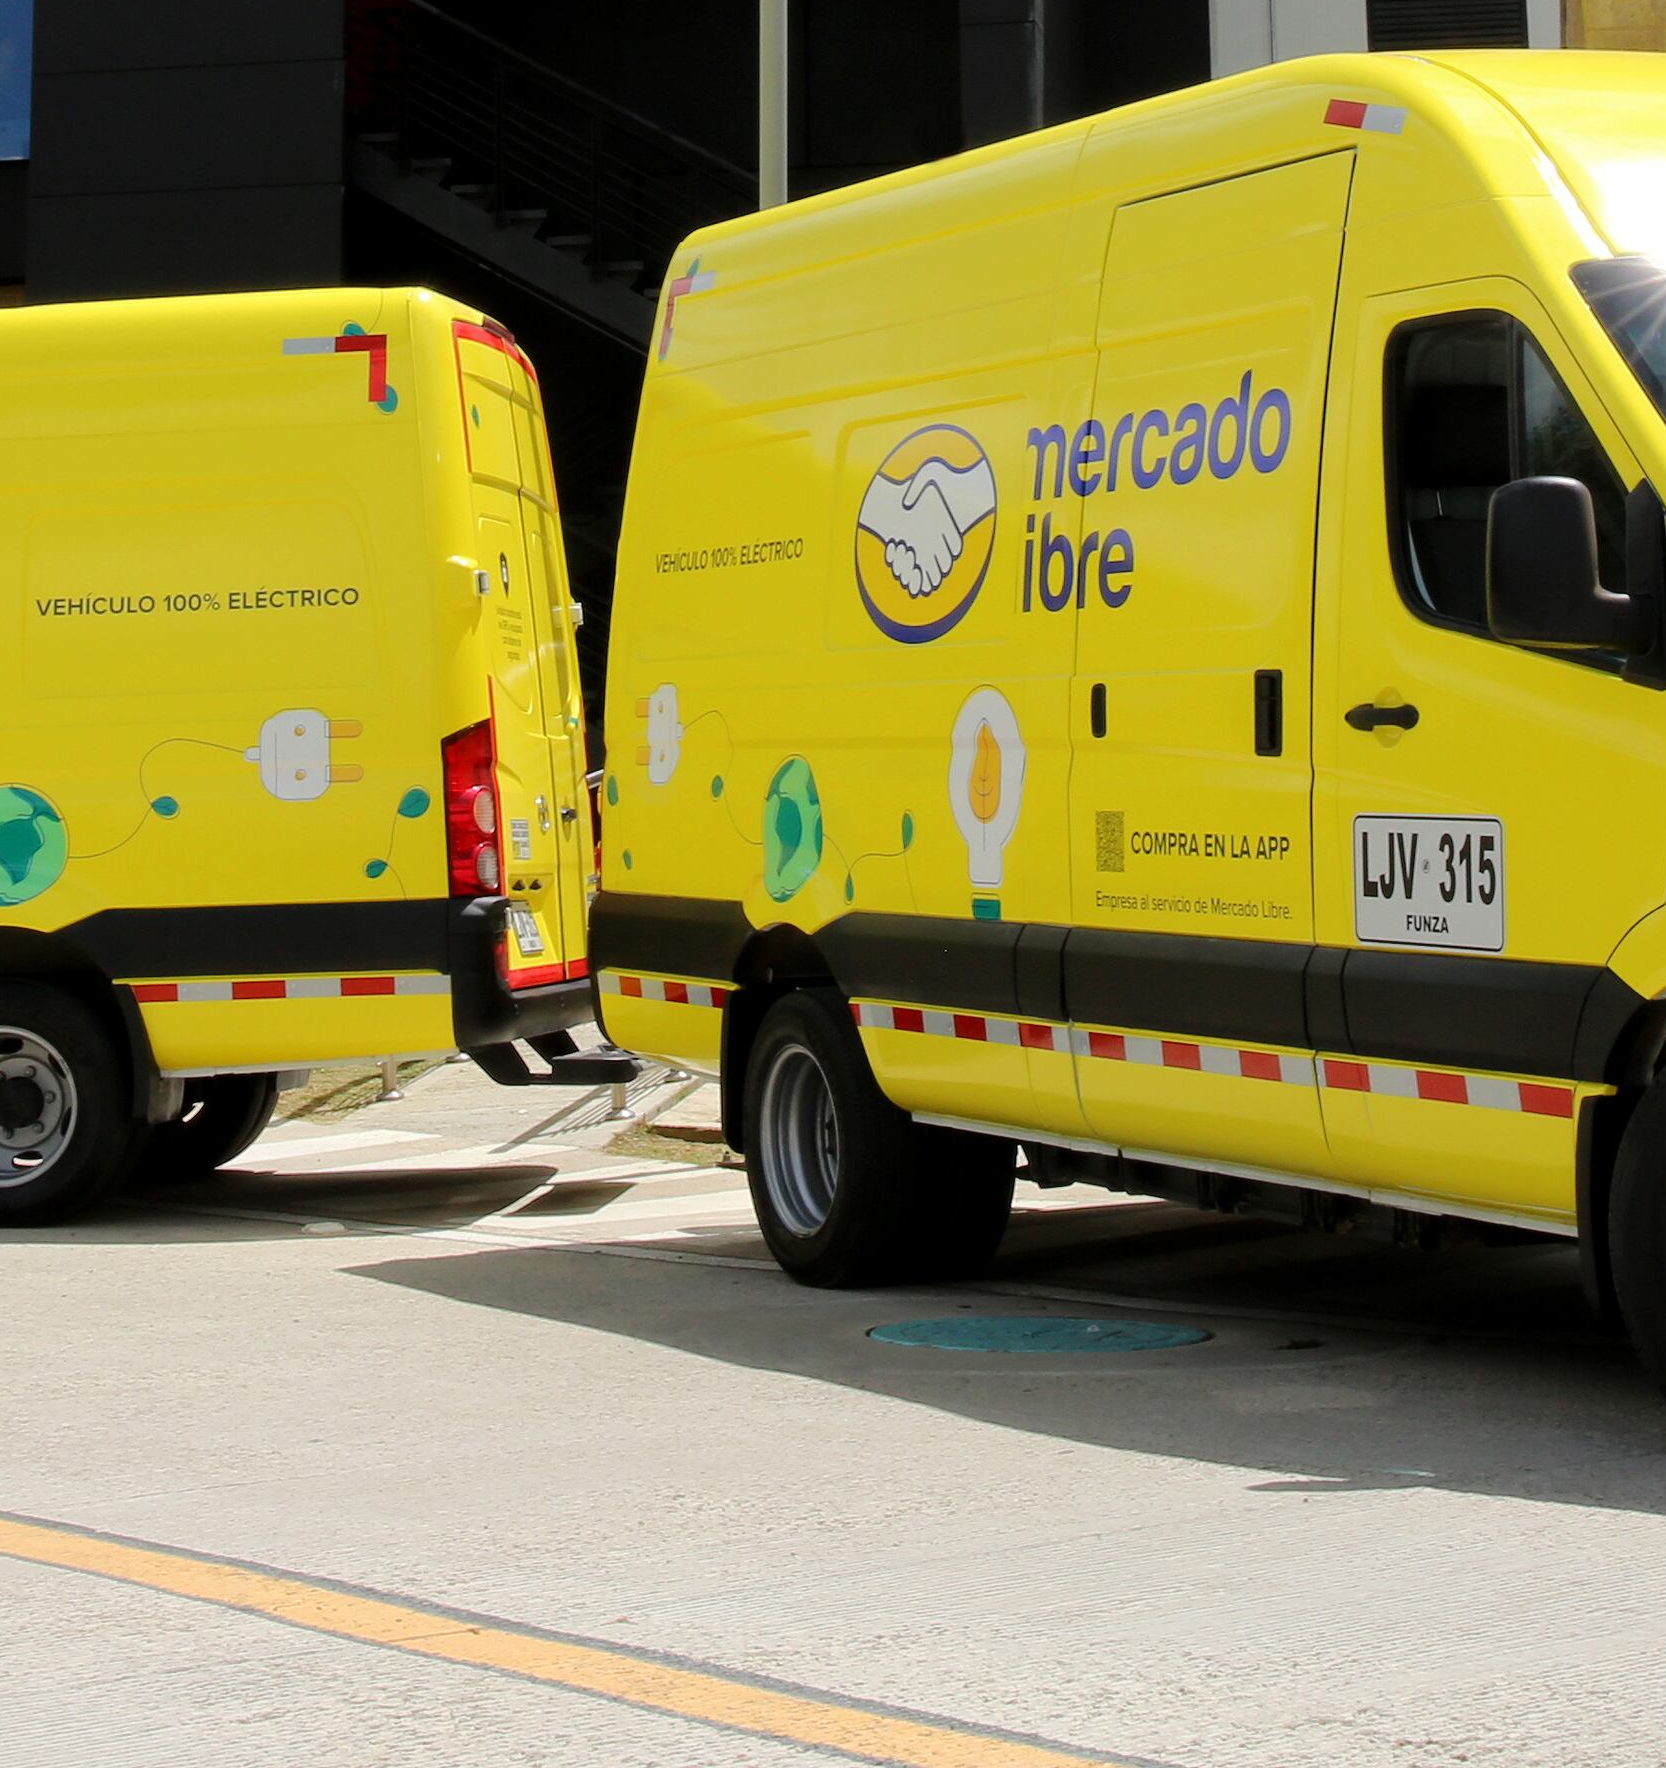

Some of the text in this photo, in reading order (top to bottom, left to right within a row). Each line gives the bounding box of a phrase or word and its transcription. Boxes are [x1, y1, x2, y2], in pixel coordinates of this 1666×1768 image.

[655, 538, 803, 573] VEHÍCULO 100% ELÉCTRICO
[1023, 511, 1134, 613] ibre
[36, 586, 359, 616] VEHÍCULO 100% ELÉCTRICO
[1131, 831, 1290, 860] COMPRA EN LA APP
[1362, 832, 1496, 905] LJV 315
[1096, 891, 1293, 920] Empresa al servicio de Mercado Libre.
[1406, 915, 1449, 933] FUNZA
